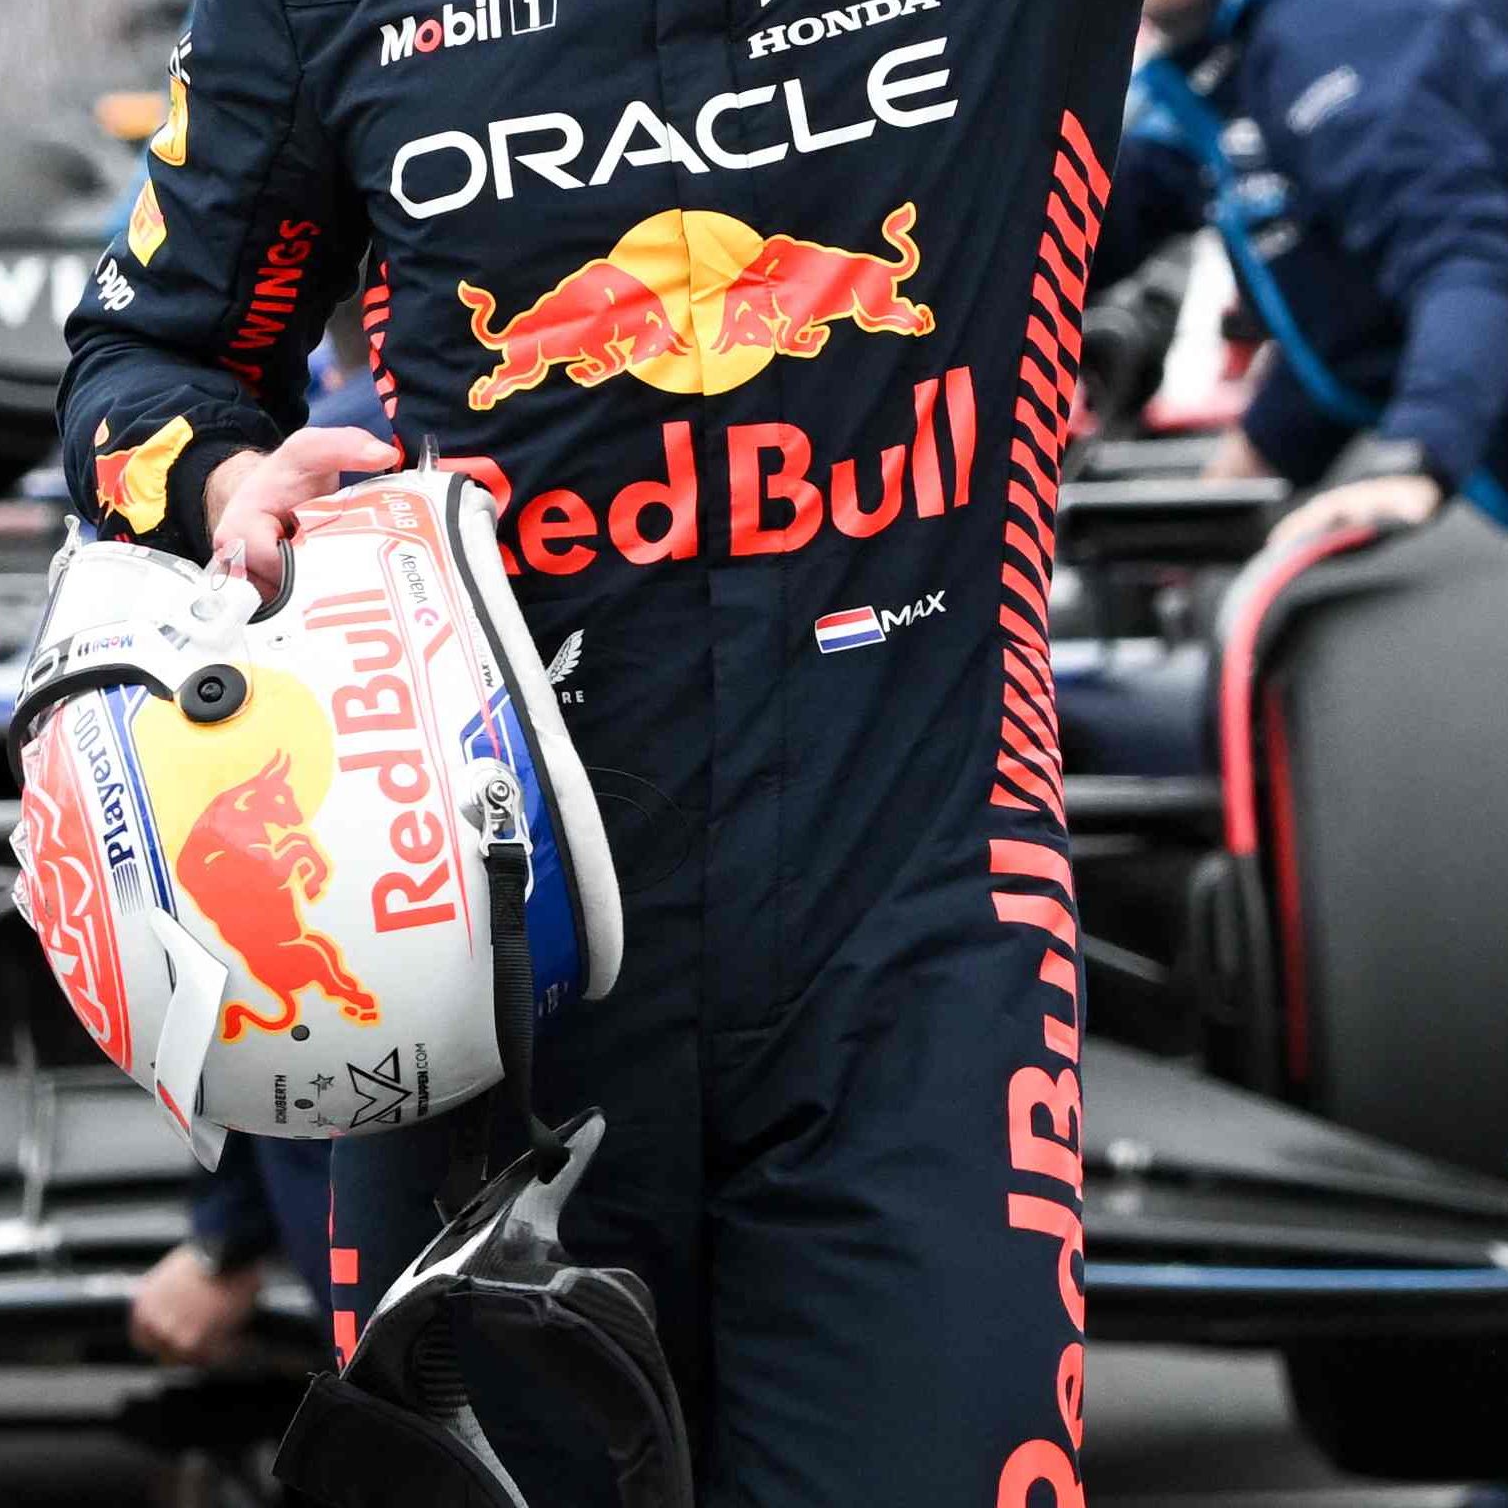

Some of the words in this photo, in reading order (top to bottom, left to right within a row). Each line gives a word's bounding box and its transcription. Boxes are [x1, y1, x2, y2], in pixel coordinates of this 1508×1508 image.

[390, 36, 959, 219] ORACLE
[229, 220, 322, 350] WINGS
[726, 366, 977, 557] Bull
[303, 588, 417, 736] Bull
[880, 590, 946, 633] MAX
[90, 745, 136, 871] Player
[339, 749, 456, 934] Red
